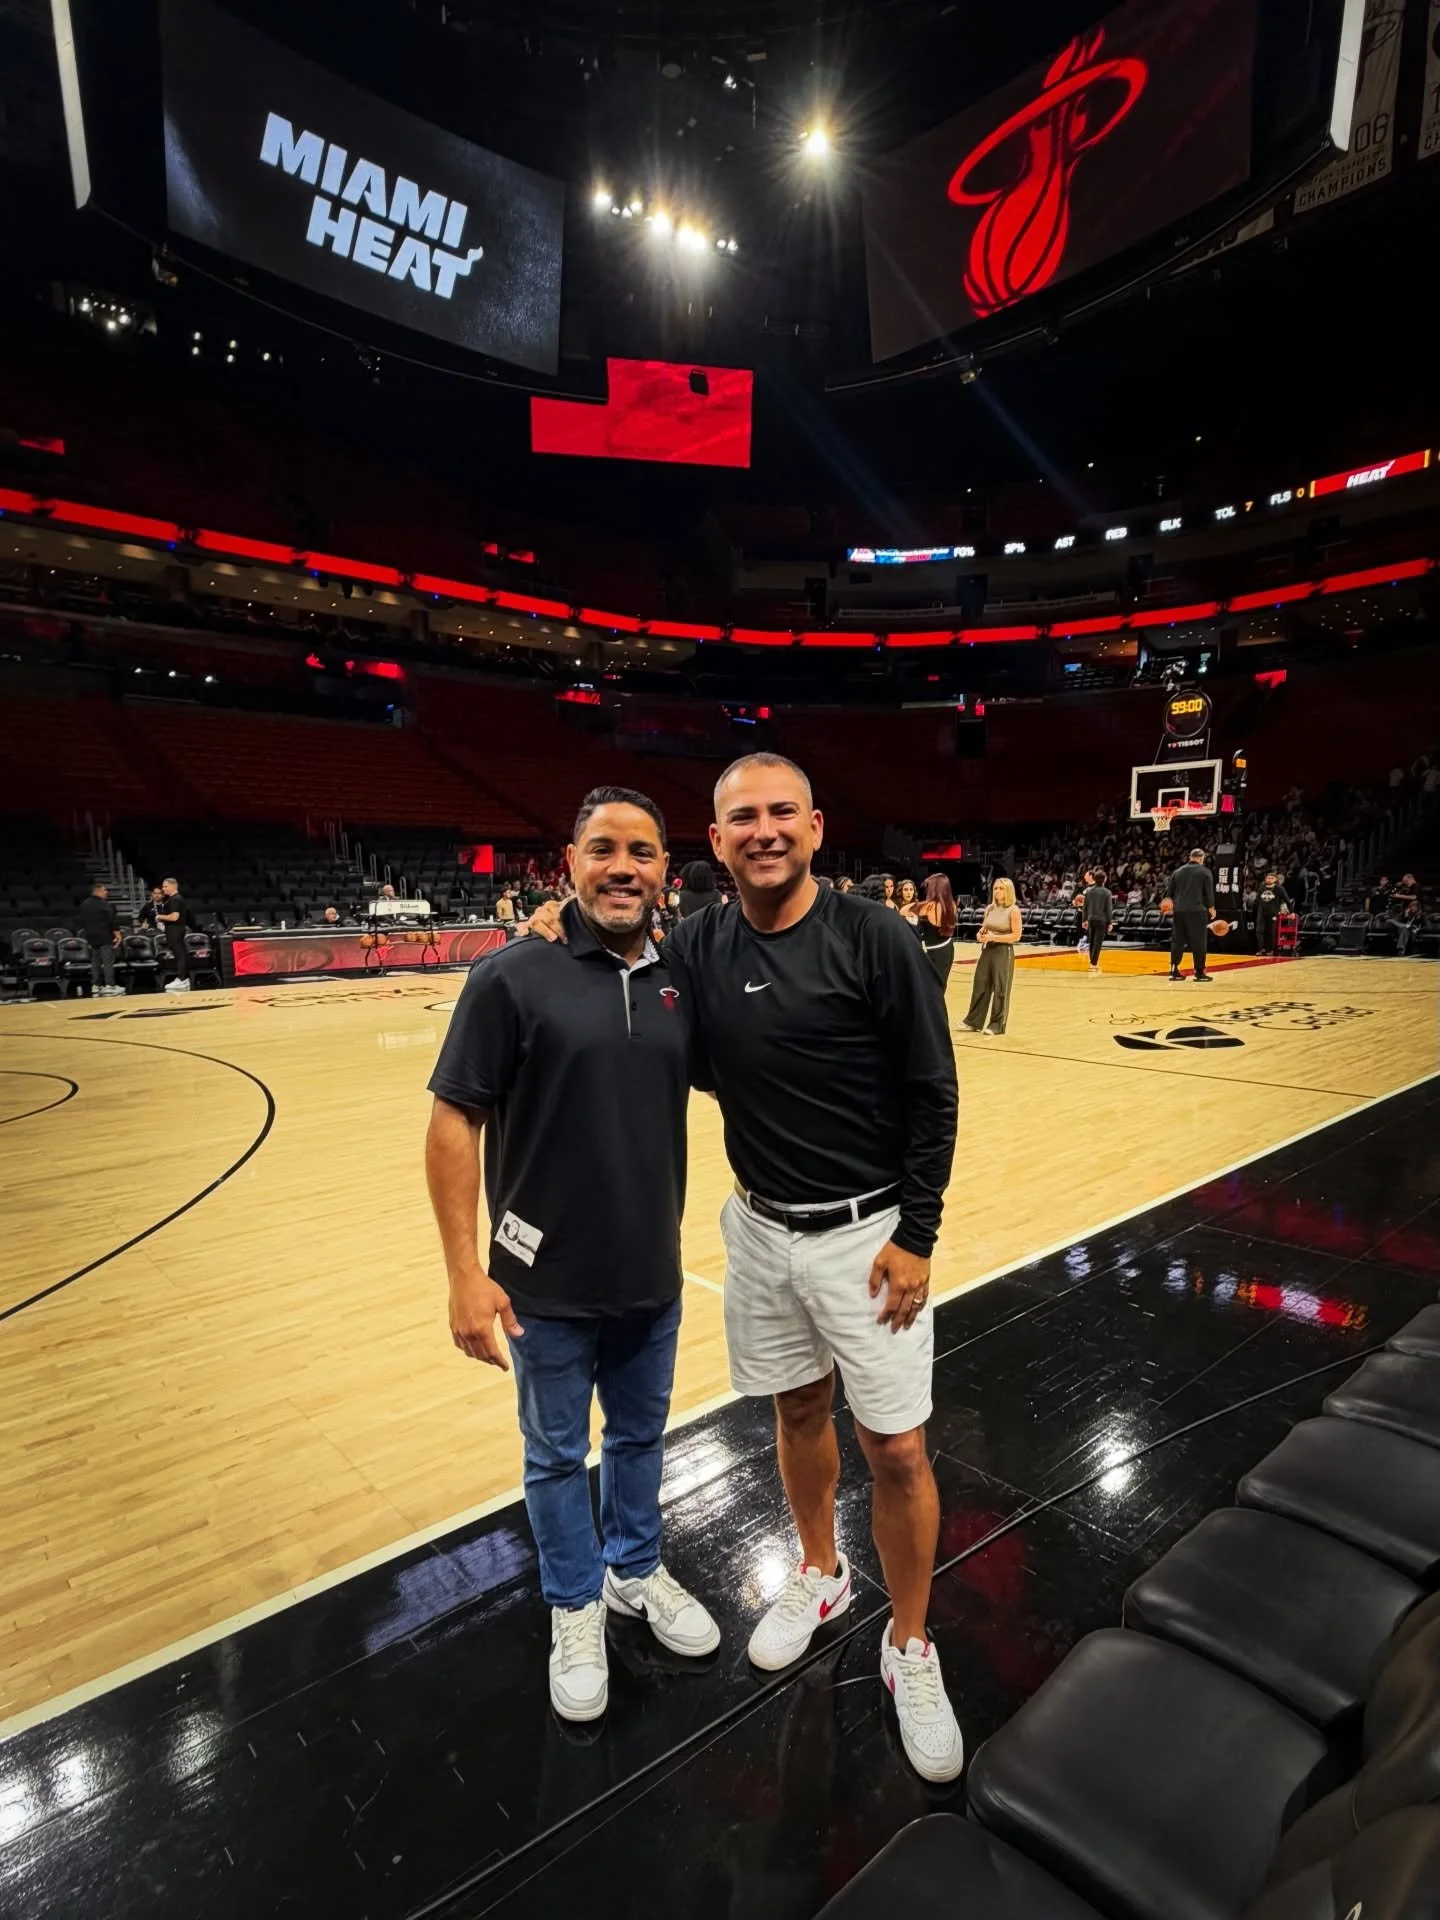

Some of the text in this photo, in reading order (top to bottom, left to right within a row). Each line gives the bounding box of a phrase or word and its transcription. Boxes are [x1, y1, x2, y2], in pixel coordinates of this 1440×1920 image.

[260, 112, 468, 248] MIAMI
[1299, 157, 1386, 207] CHAMPIONS
[306, 195, 483, 299] HEAT
[1346, 460, 1395, 488] HEAT
[1270, 487, 1305, 506] FLS 0
[1215, 501, 1253, 520] TOL 7
[1055, 535, 1075, 549] AST
[1171, 699, 1203, 715] 99:00
[1178, 738, 1205, 748] TISSOT
